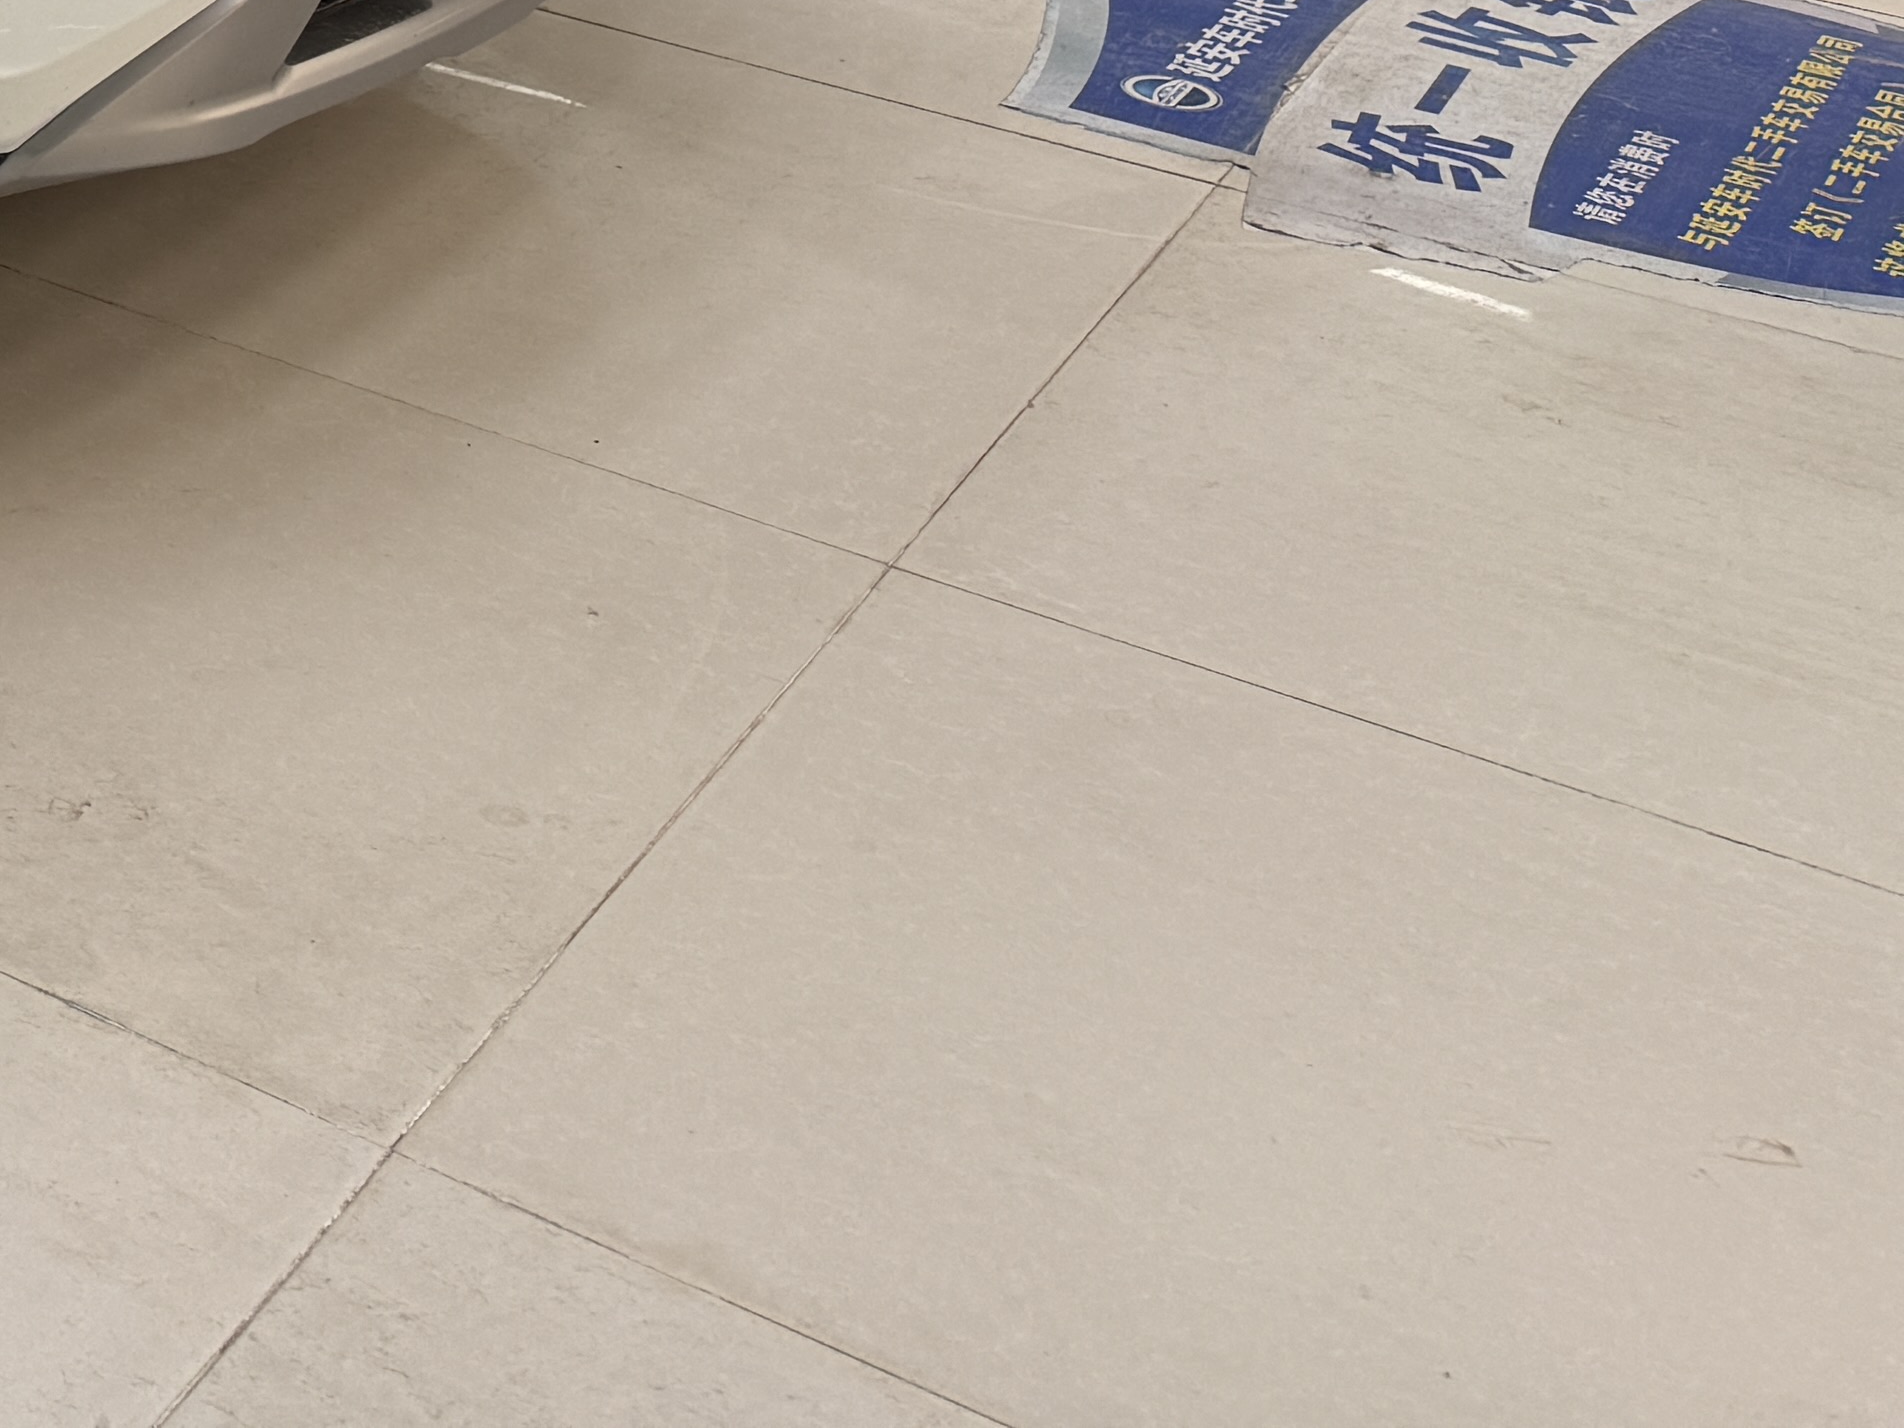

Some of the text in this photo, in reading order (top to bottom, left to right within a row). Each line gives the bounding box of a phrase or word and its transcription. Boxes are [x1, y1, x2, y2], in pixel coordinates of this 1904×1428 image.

[1572, 129, 1680, 226] 请您在消费时
[1677, 34, 1864, 252] 与延安车时代二手车交易有限公司
